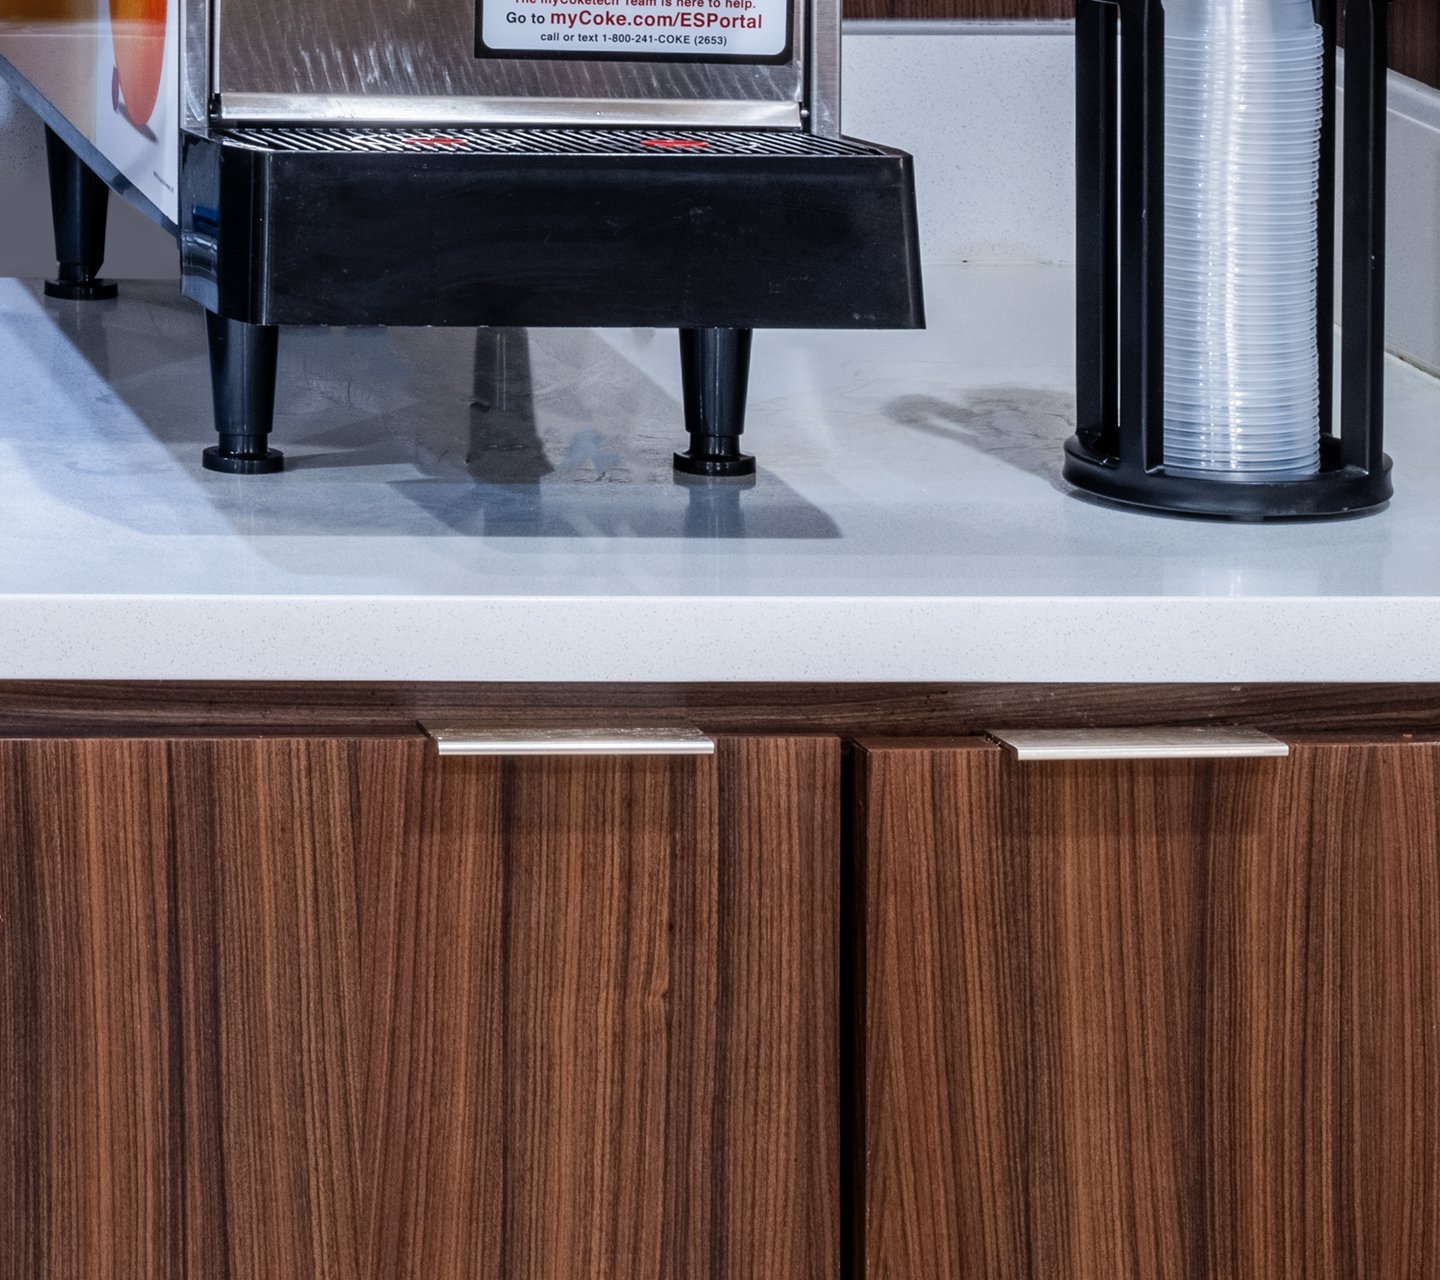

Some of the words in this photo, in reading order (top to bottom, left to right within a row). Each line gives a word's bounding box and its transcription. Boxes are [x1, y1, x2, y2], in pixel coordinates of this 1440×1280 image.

[506, 11, 526, 23] Go
[531, 13, 545, 24] to
[550, 9, 762, 29] myCoke.com/ESPortal
[540, 32, 559, 41] call
[578, 33, 598, 42] text
[602, 33, 690, 44] 1-800-241-COKE
[693, 35, 727, 47] (2653)
